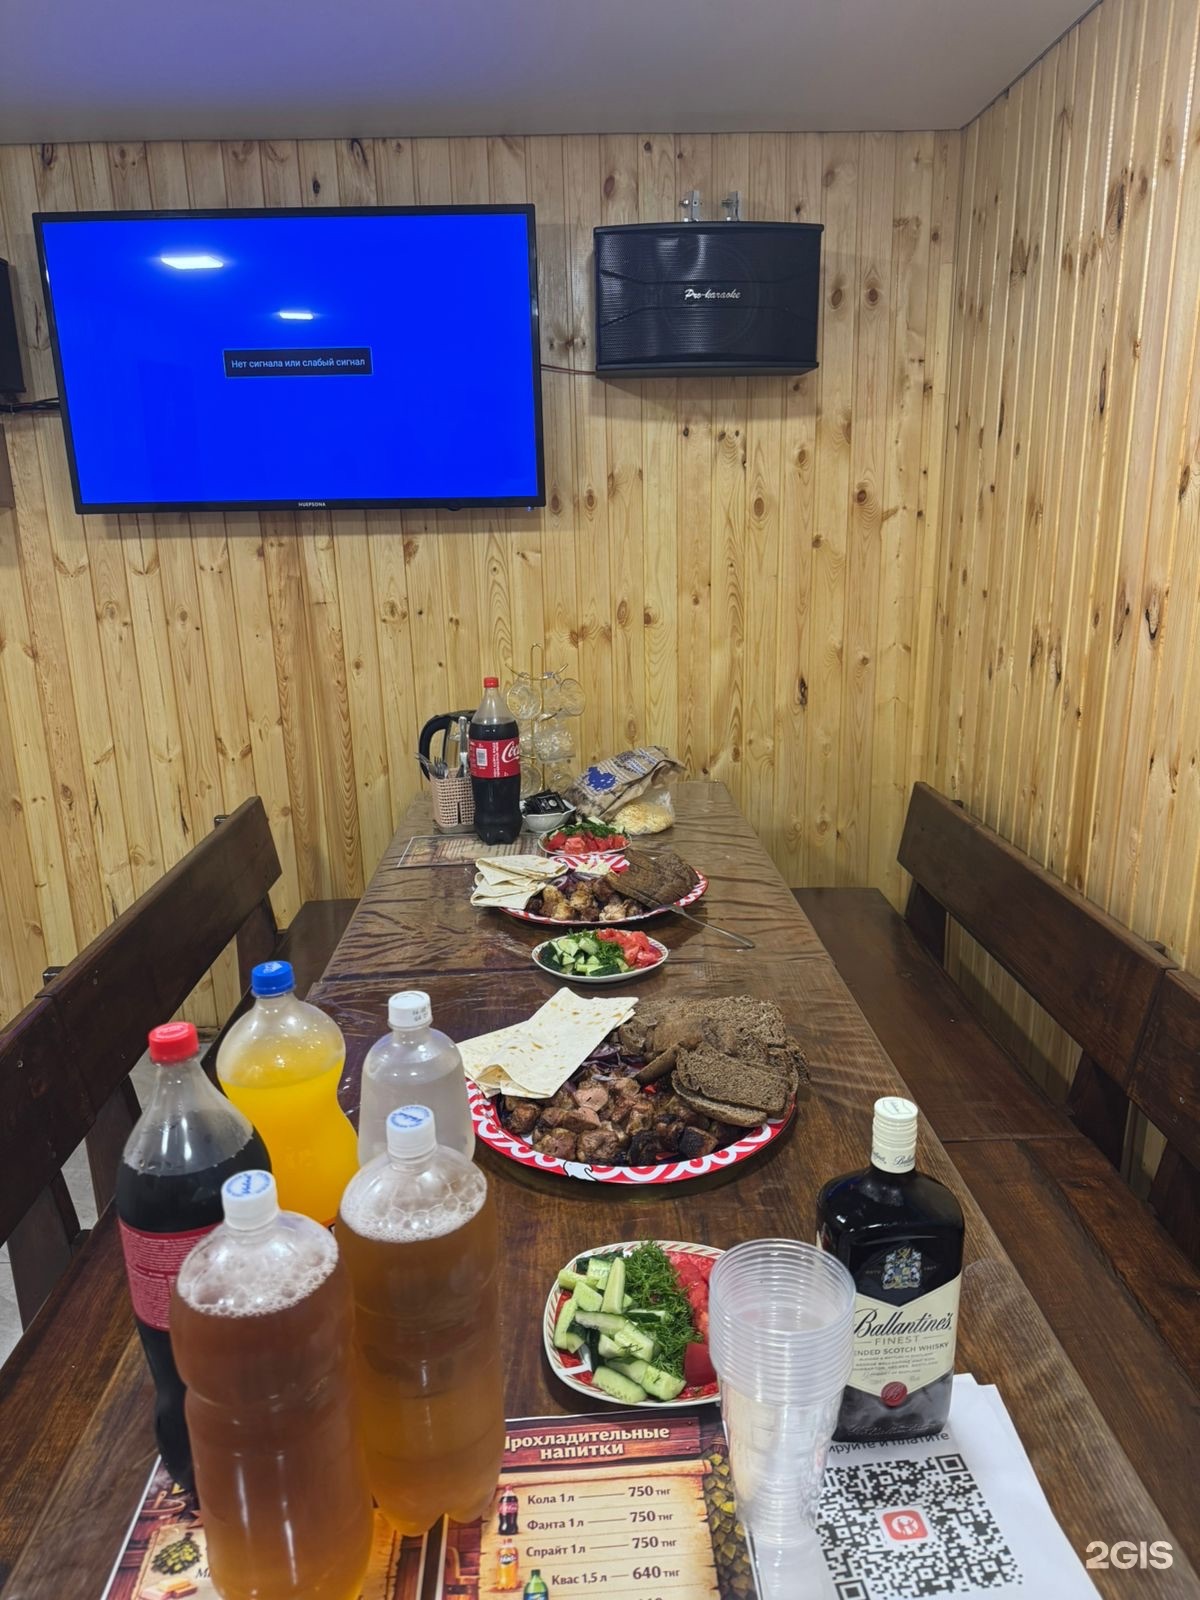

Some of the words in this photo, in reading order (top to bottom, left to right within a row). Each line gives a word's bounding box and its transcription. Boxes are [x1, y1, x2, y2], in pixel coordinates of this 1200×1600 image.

[684, 288, 741, 300] Pro-karaoke
[231, 360, 247, 368] Нет
[302, 358, 334, 367] слабый
[336, 359, 365, 367] сигнал
[874, 1335, 919, 1346] FINEST
[854, 1348, 881, 1357] ENDED
[883, 1346, 916, 1355] SCOTCH
[919, 1342, 949, 1352] WHISKY
[540, 1443, 624, 1460] напитки
[528, 1494, 556, 1505] Кола
[628, 1485, 653, 1497] 750
[656, 1488, 671, 1496] тнг
[527, 1520, 566, 1530] Фанта
[629, 1510, 656, 1522] 750
[658, 1513, 673, 1521] тнг
[526, 1545, 568, 1559] Спрайт
[632, 1536, 659, 1549] 750
[661, 1539, 677, 1547] тнг
[551, 1575, 579, 1586] Квас
[582, 1572, 598, 1584] 1,5
[632, 1565, 661, 1580] 640
[663, 1569, 680, 1577] тнг
